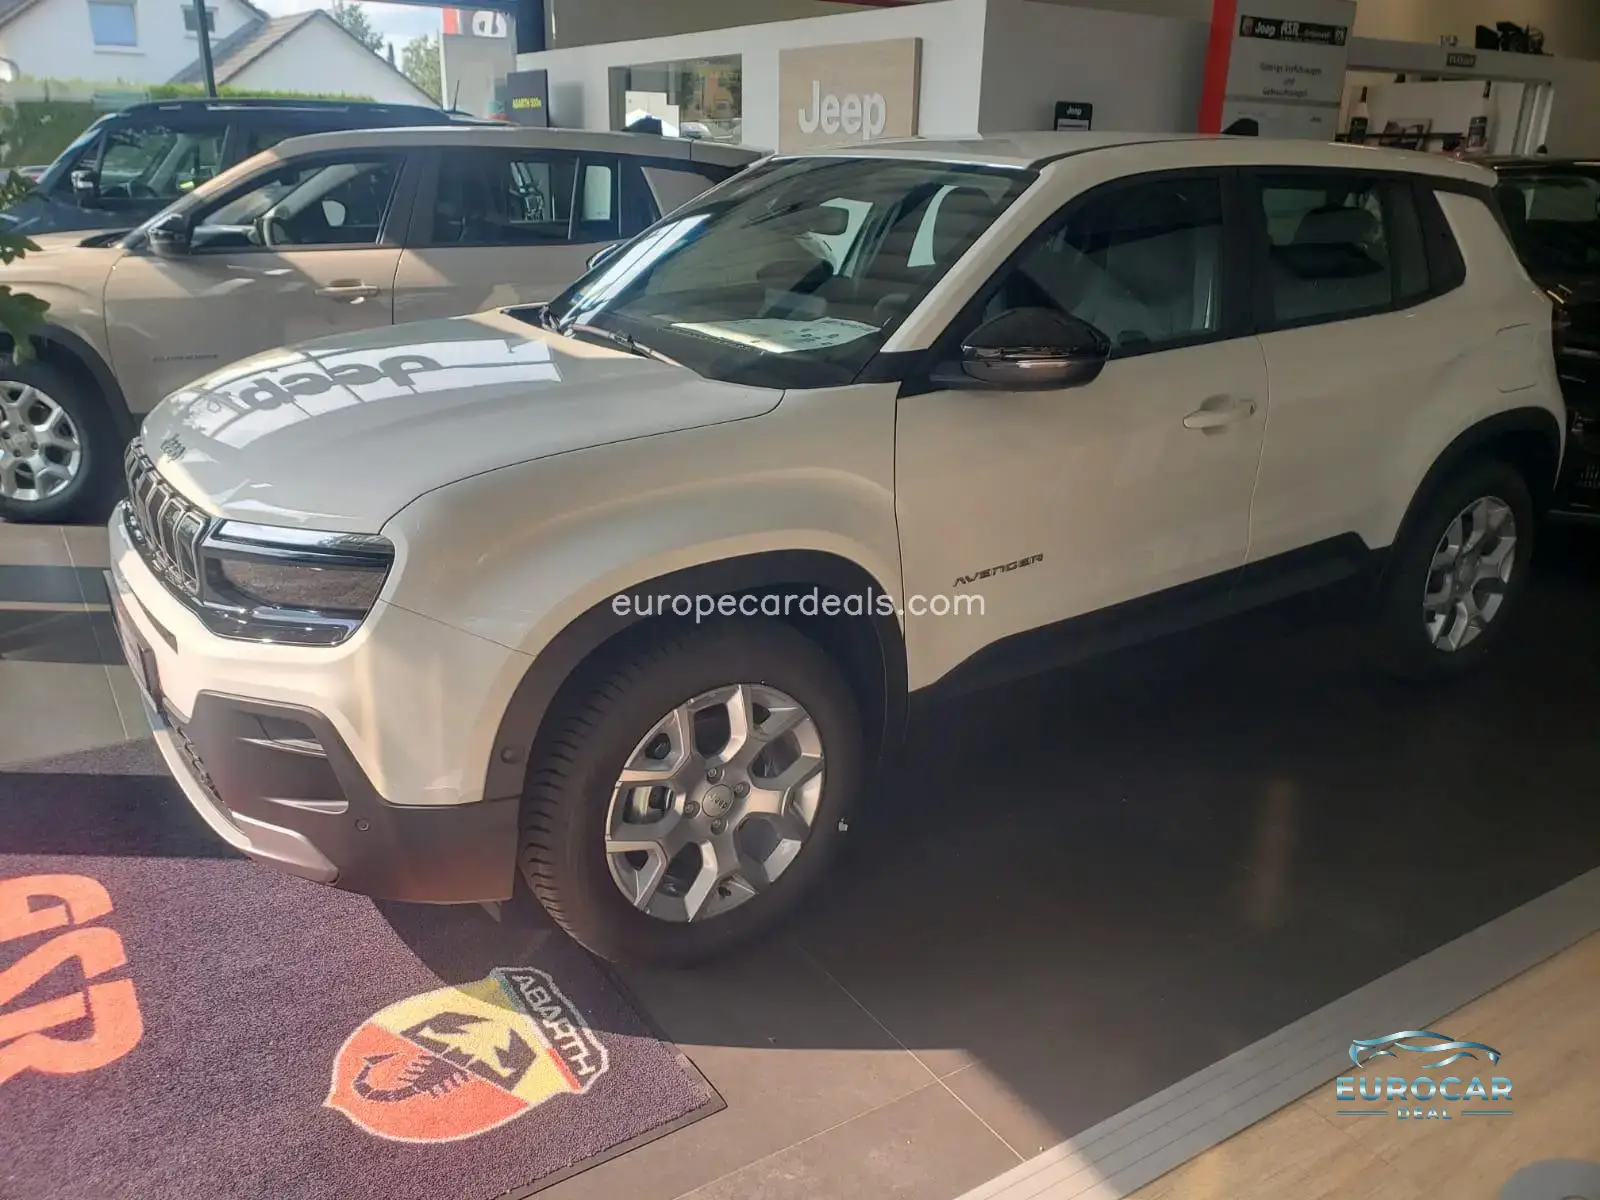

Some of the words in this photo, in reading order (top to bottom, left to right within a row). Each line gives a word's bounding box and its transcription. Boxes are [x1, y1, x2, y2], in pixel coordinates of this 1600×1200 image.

[798, 80, 886, 141] Jeep
[952, 553, 1043, 587] AVENGER
[511, 975, 596, 1076] ABARTH
